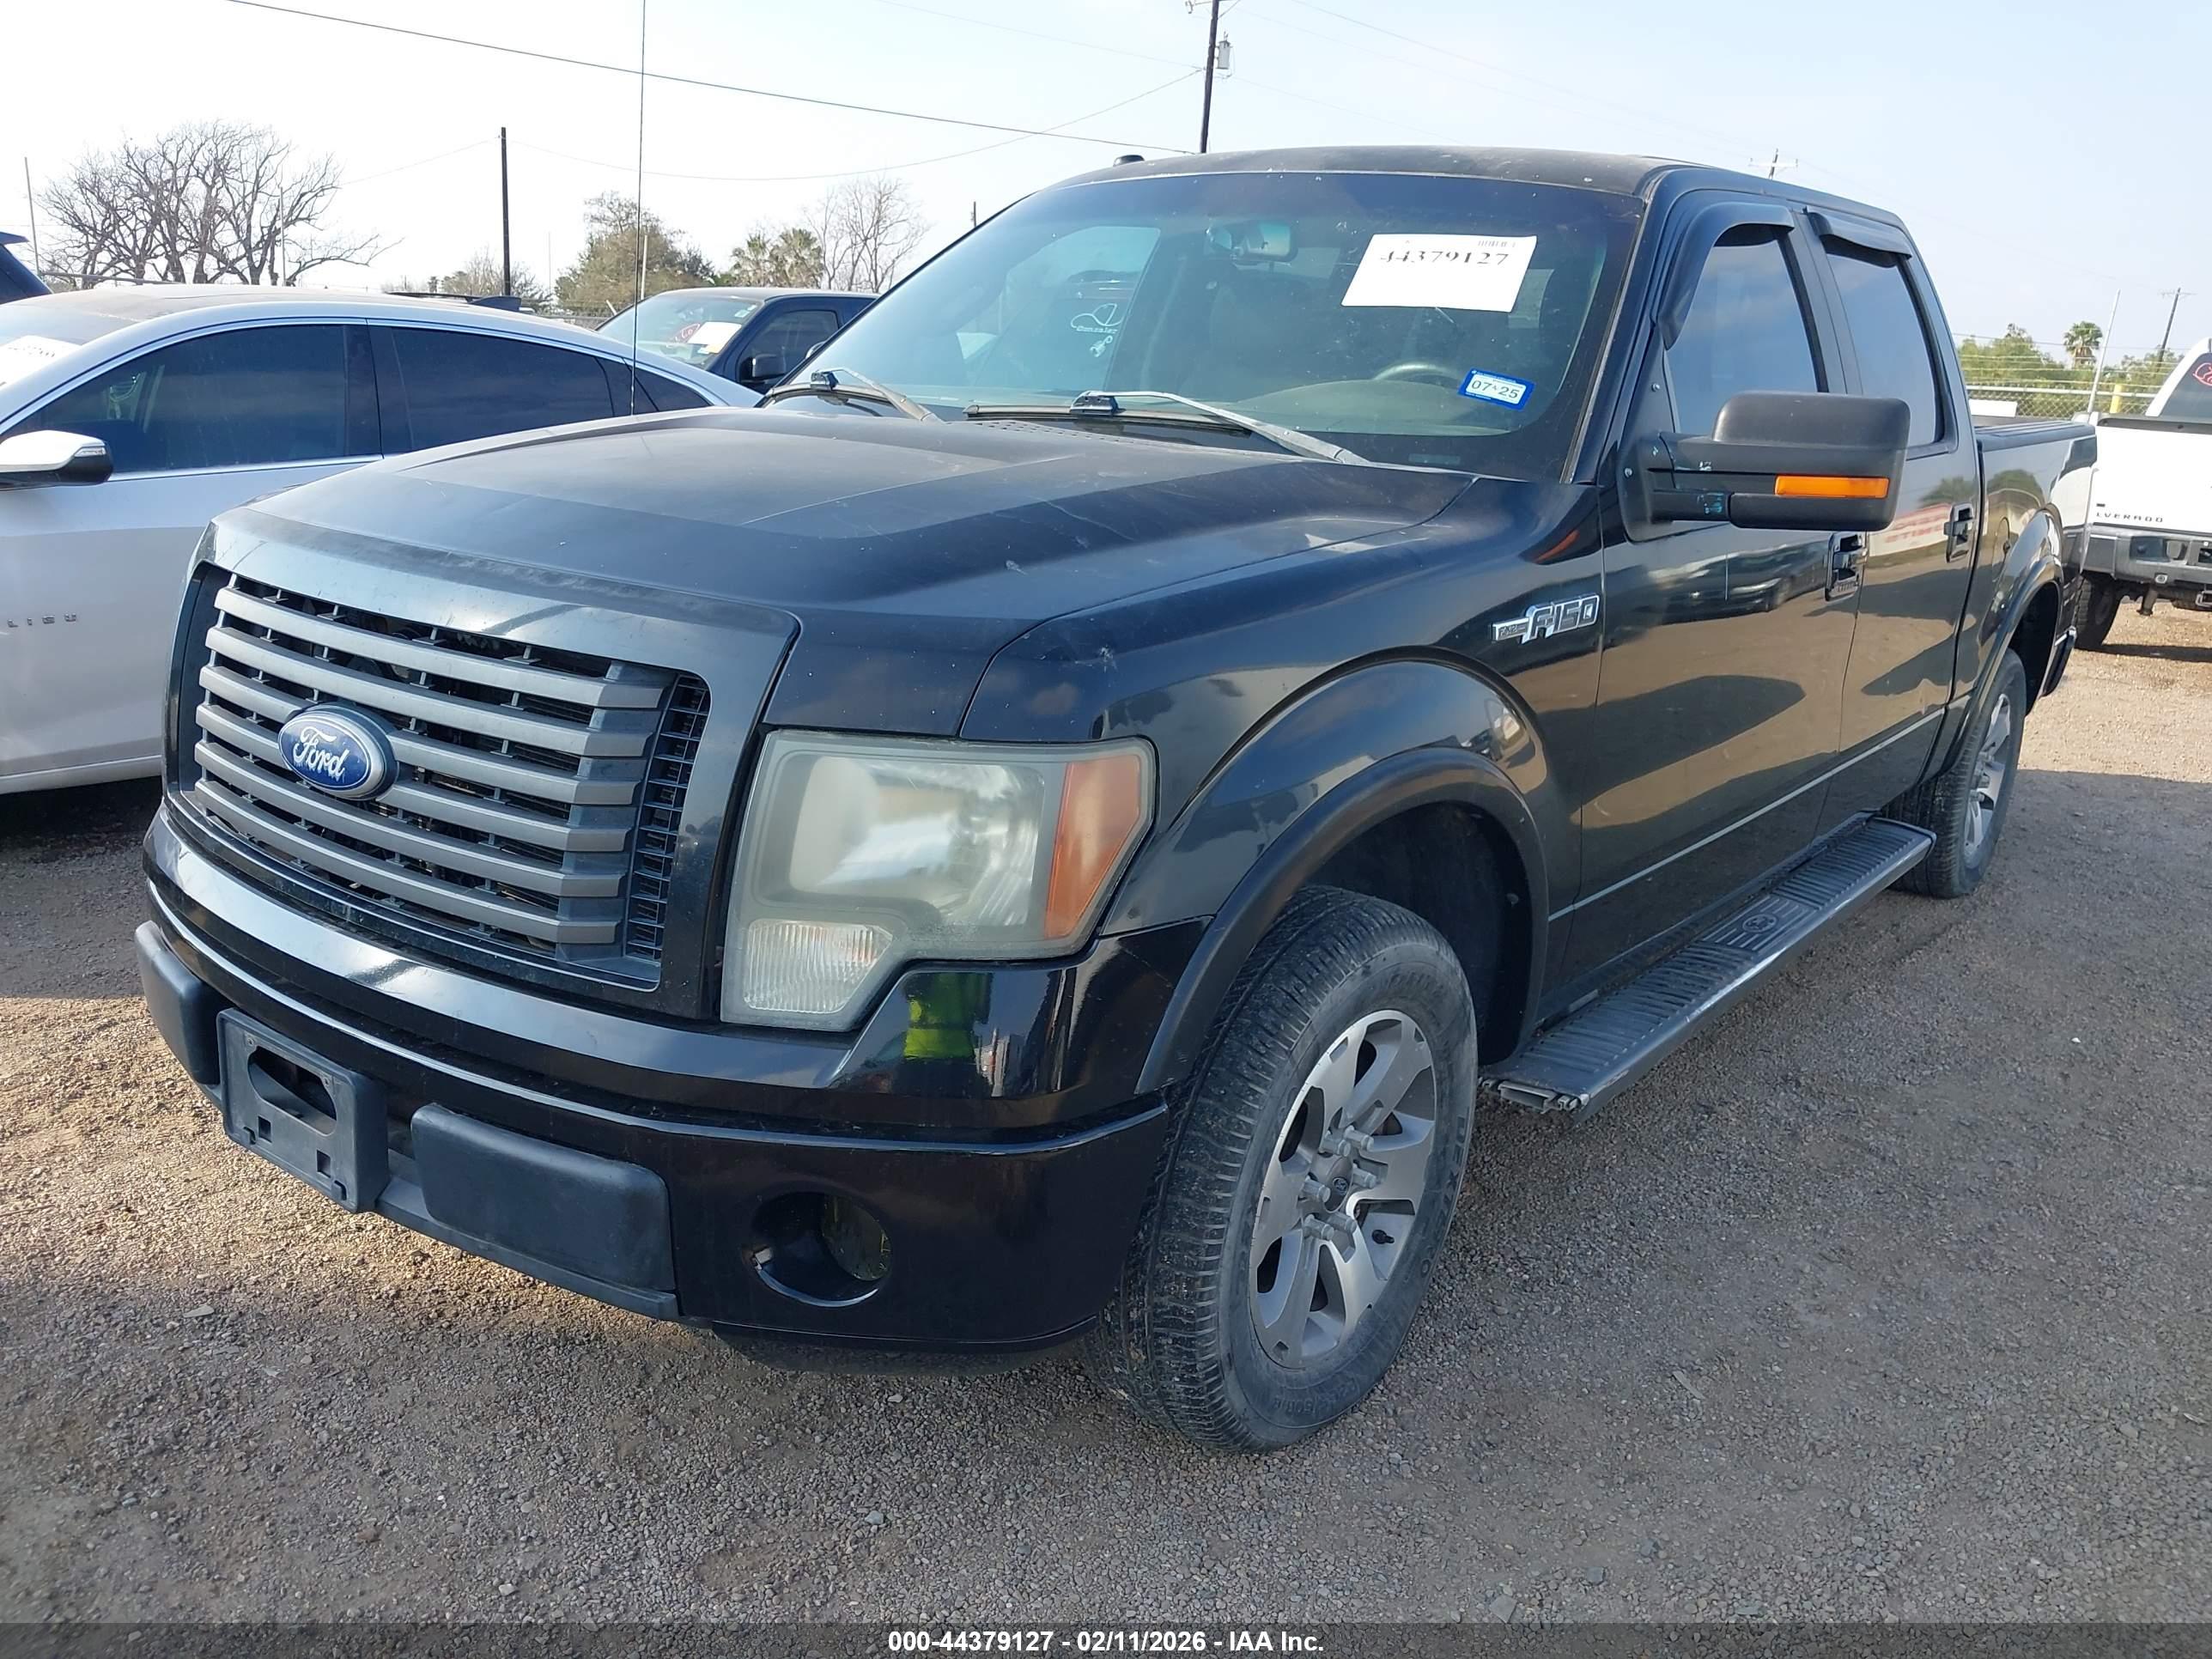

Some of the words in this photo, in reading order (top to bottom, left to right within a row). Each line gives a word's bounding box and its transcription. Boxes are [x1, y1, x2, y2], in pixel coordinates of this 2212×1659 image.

[1471, 380, 1492, 392] 07
[1498, 386, 1520, 398] 25
[292, 726, 350, 778] Ford
